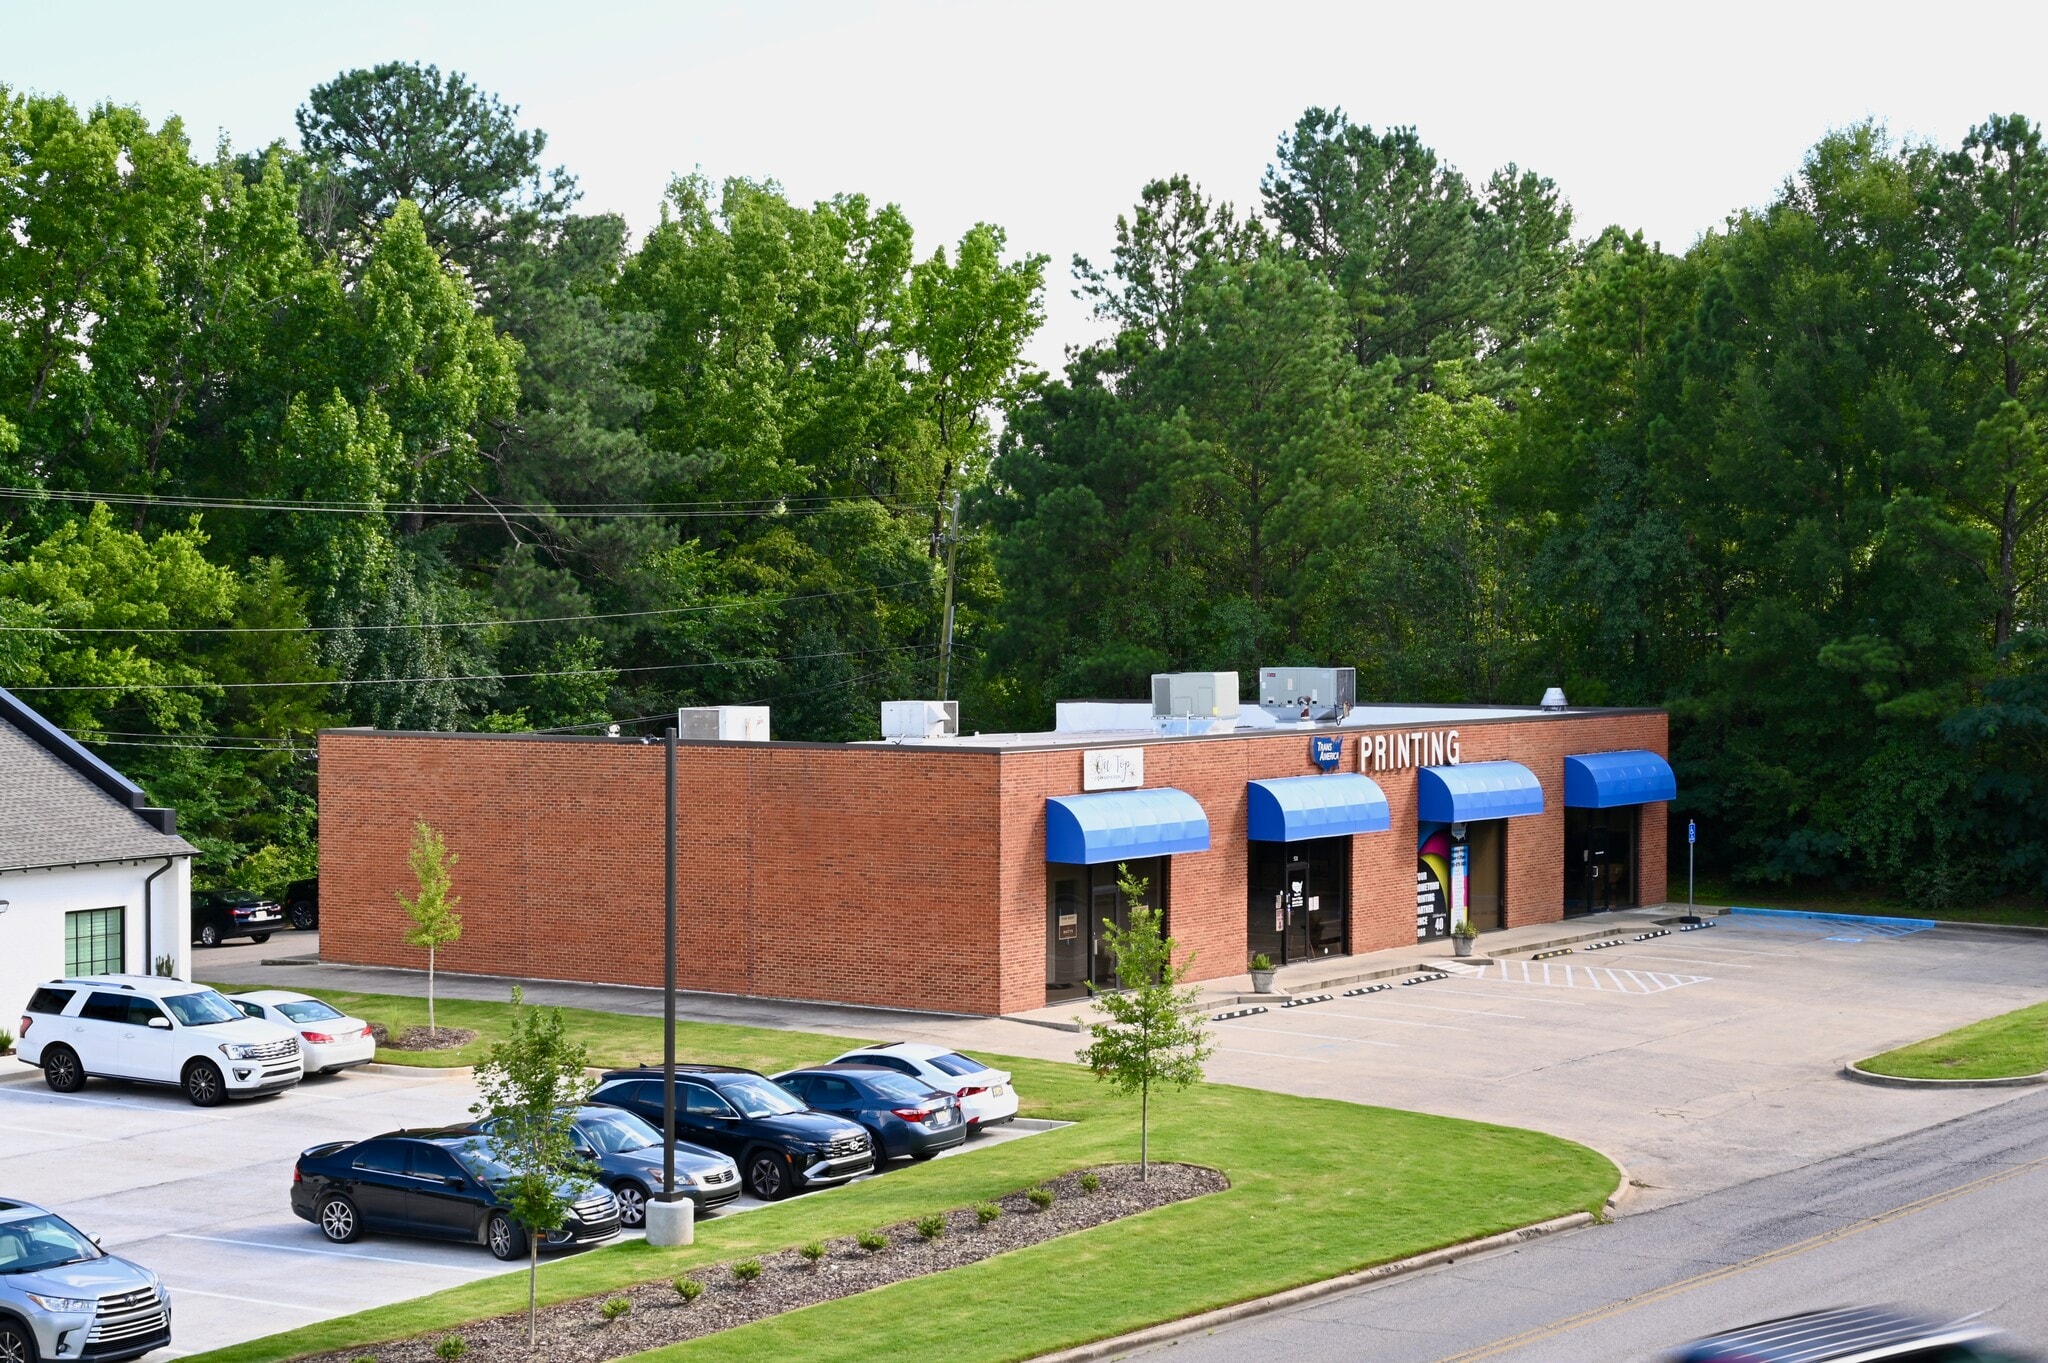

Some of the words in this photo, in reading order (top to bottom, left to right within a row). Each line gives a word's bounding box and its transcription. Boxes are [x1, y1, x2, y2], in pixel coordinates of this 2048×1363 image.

[1317, 741, 1332, 752] TRANS
[1361, 730, 1459, 772] PRINTING
[1319, 751, 1339, 761] AMERICA
[1113, 754, 1130, 782] Top
[1418, 872, 1427, 880] OUR
[1417, 881, 1439, 892] OMETOWN
[1417, 893, 1435, 903] RINTING
[1435, 917, 1444, 930] 40
